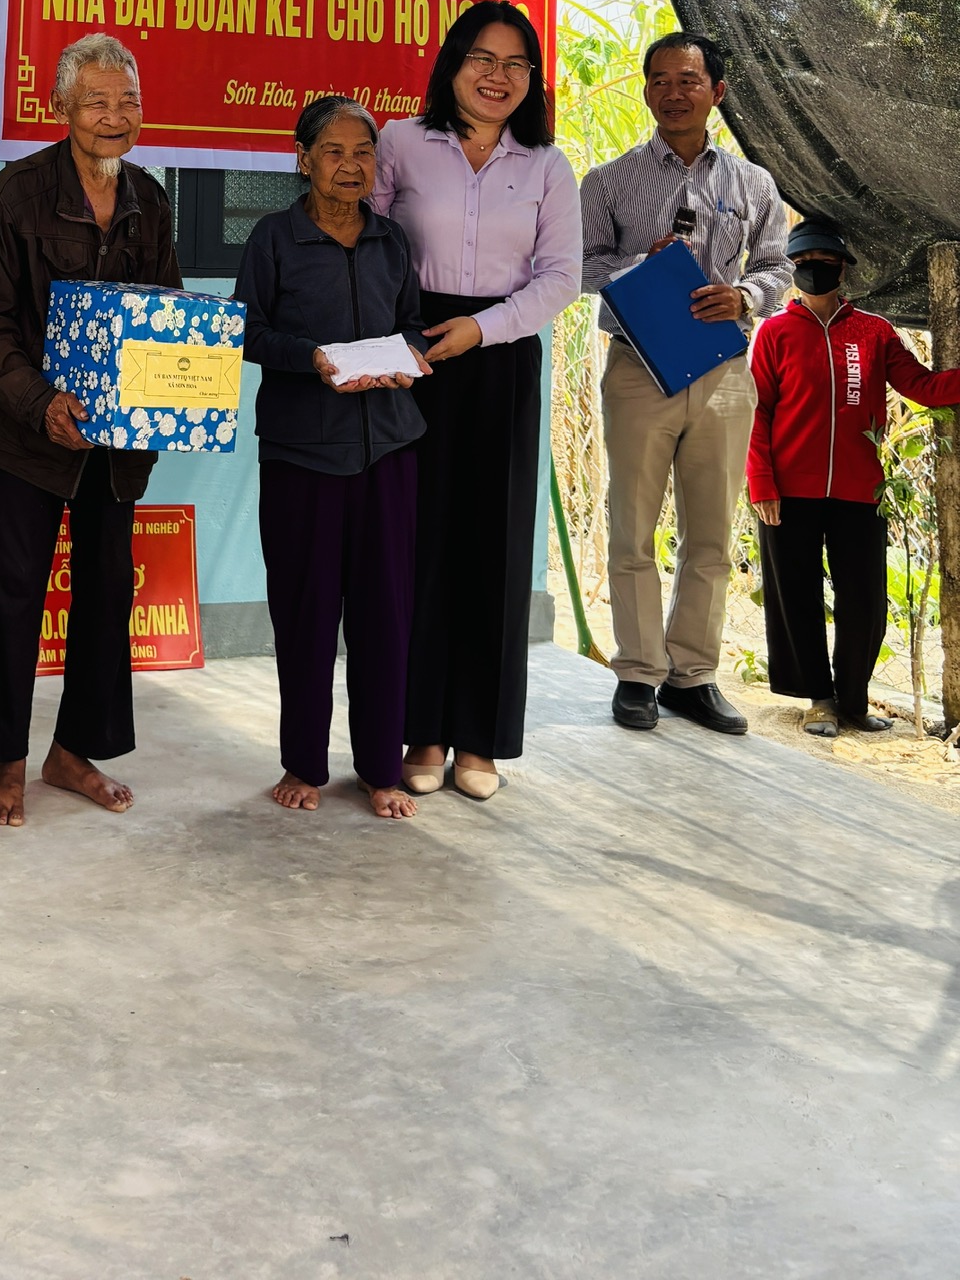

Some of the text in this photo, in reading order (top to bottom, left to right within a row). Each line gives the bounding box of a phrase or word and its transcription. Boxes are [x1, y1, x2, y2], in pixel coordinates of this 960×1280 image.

[224, 78, 256, 106] Sơn
[259, 81, 297, 110] Hòa,
[373, 87, 422, 118] tháng
